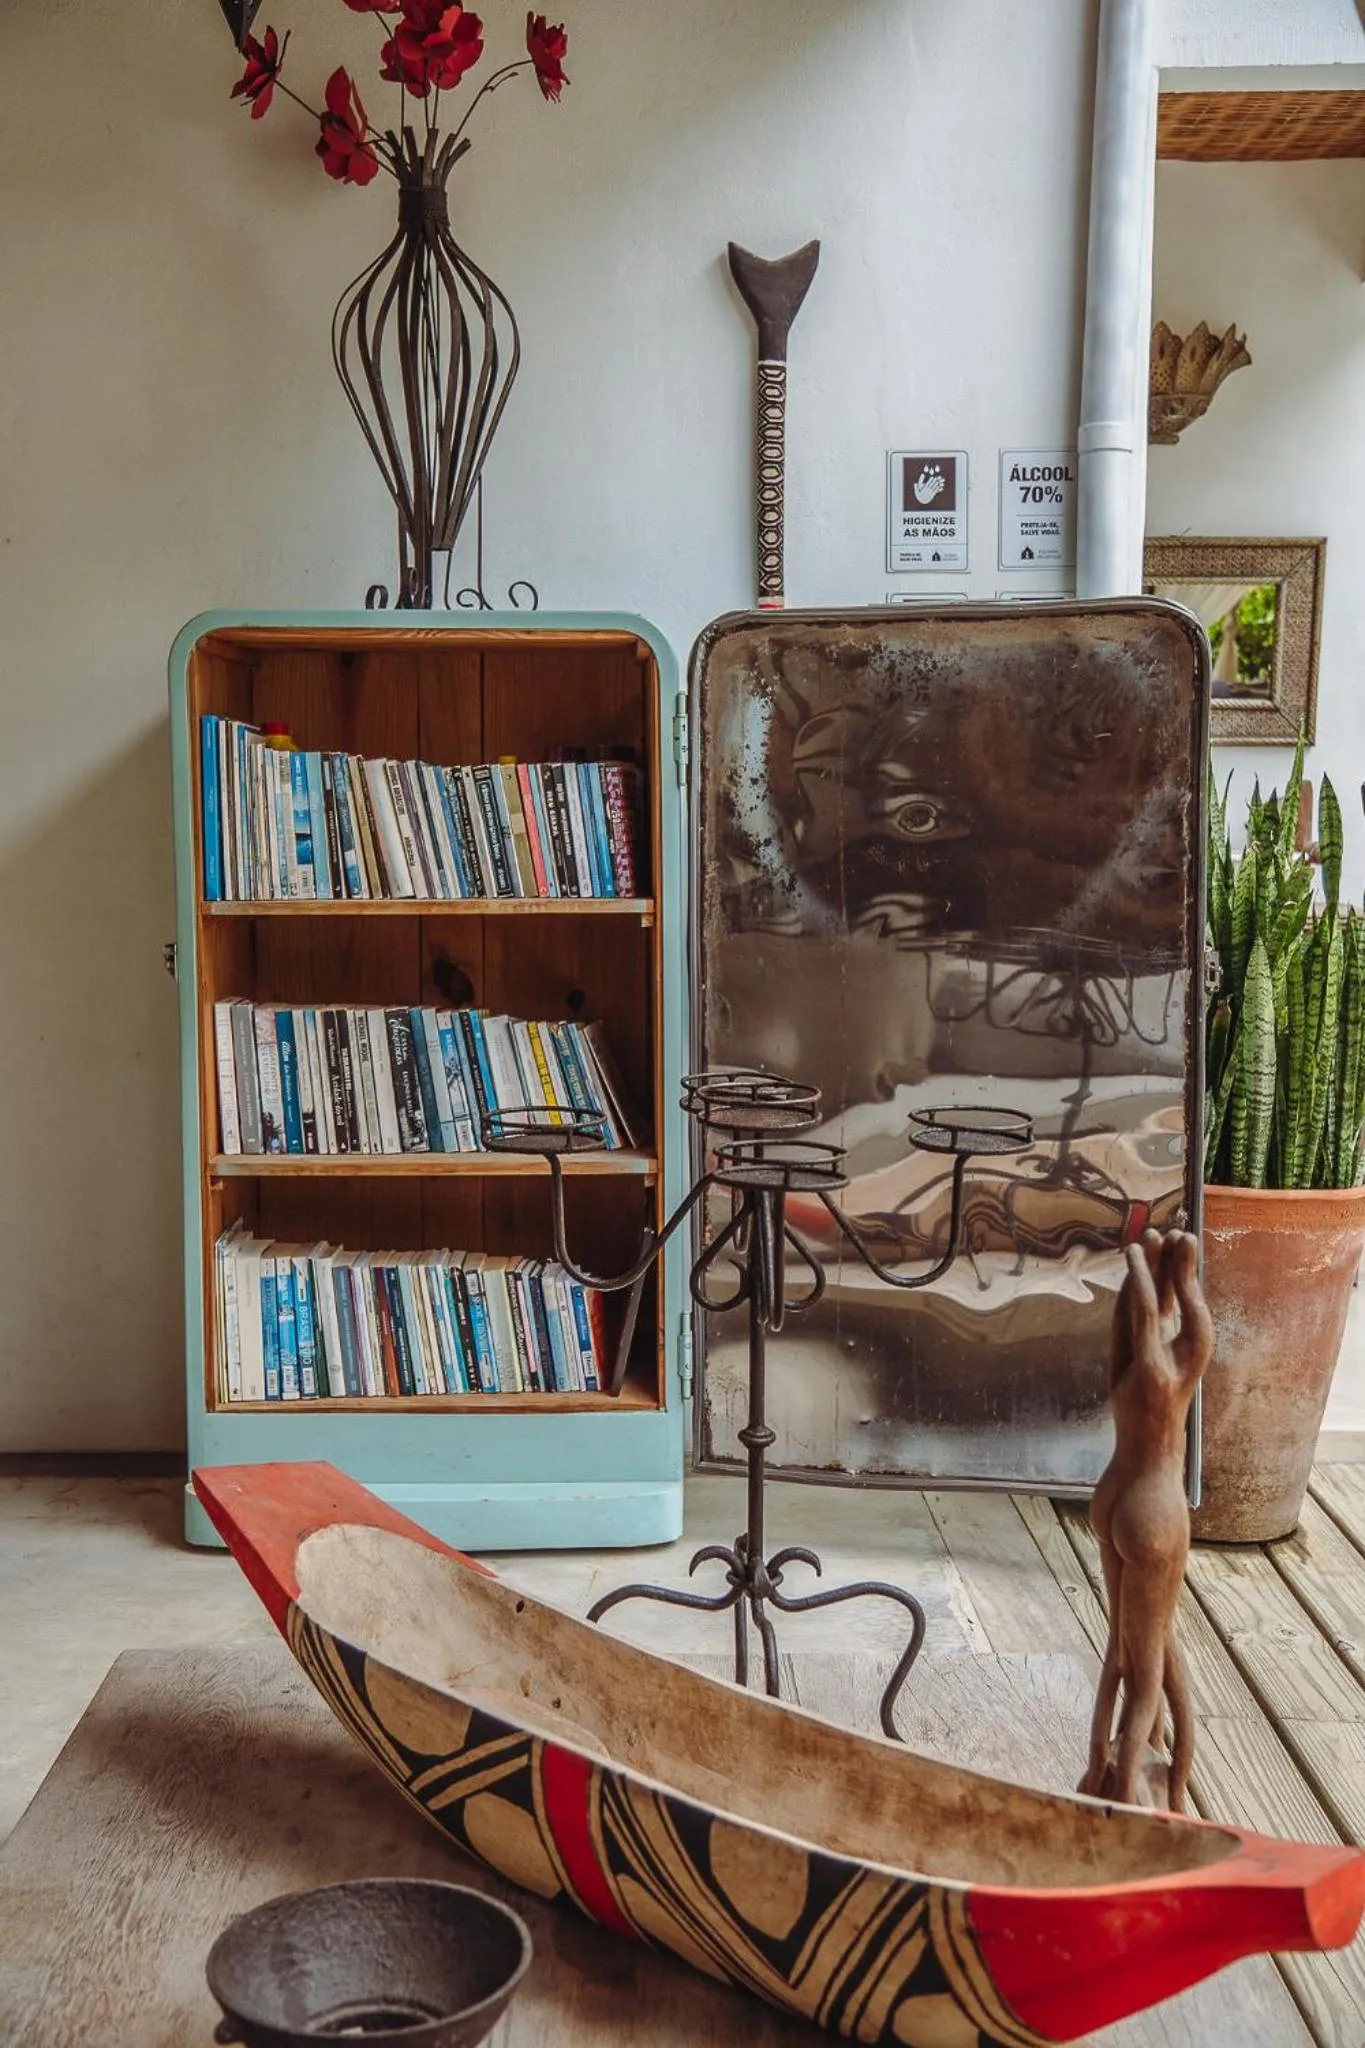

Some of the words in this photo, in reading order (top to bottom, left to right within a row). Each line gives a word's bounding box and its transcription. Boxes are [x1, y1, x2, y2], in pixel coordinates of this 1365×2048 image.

[1009, 464, 1074, 482] ÁLCOOL
[1019, 486, 1063, 503] 70%
[903, 516, 956, 525] HIGIENIZE
[903, 528, 919, 537] AS
[922, 527, 956, 537] MÃOS
